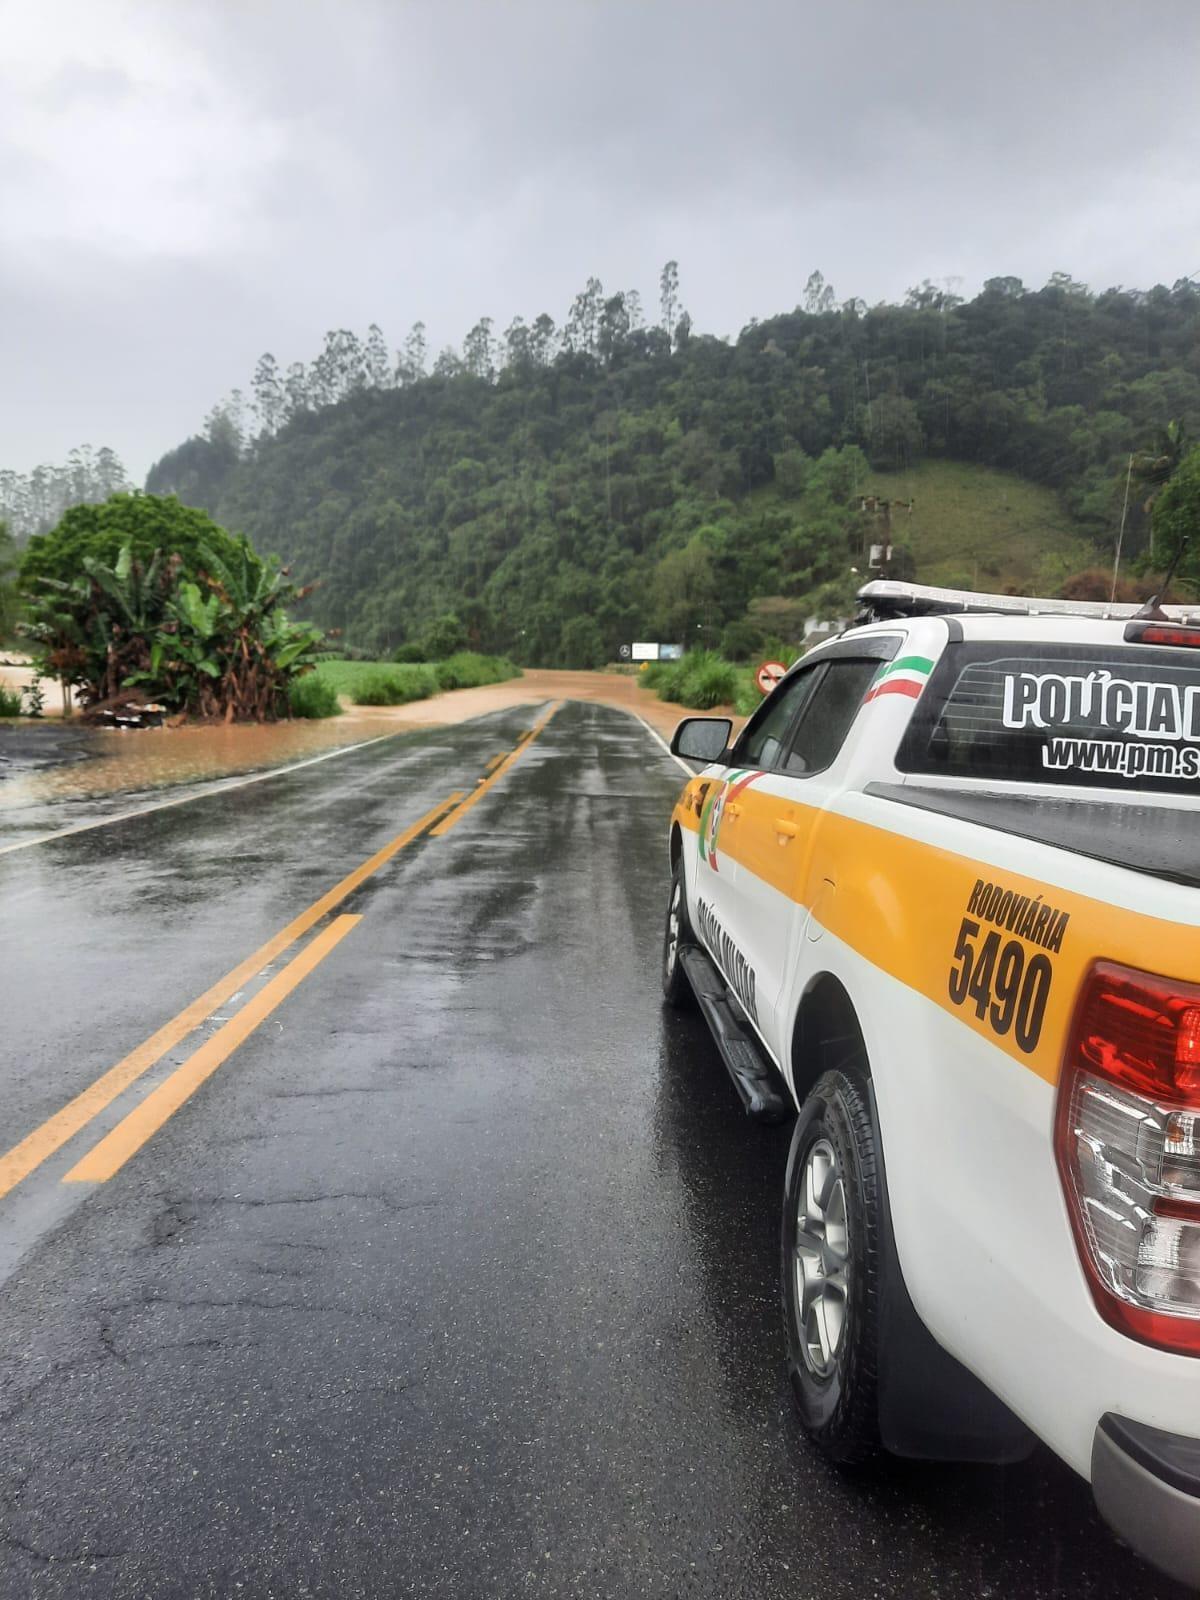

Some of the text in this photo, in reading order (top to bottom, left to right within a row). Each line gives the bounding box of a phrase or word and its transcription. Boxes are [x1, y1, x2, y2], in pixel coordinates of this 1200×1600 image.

[1004, 671, 1182, 740] POLÍCIA
[967, 879, 1070, 954] RODOVIÁRIA
[949, 917, 1053, 1054] 5490
